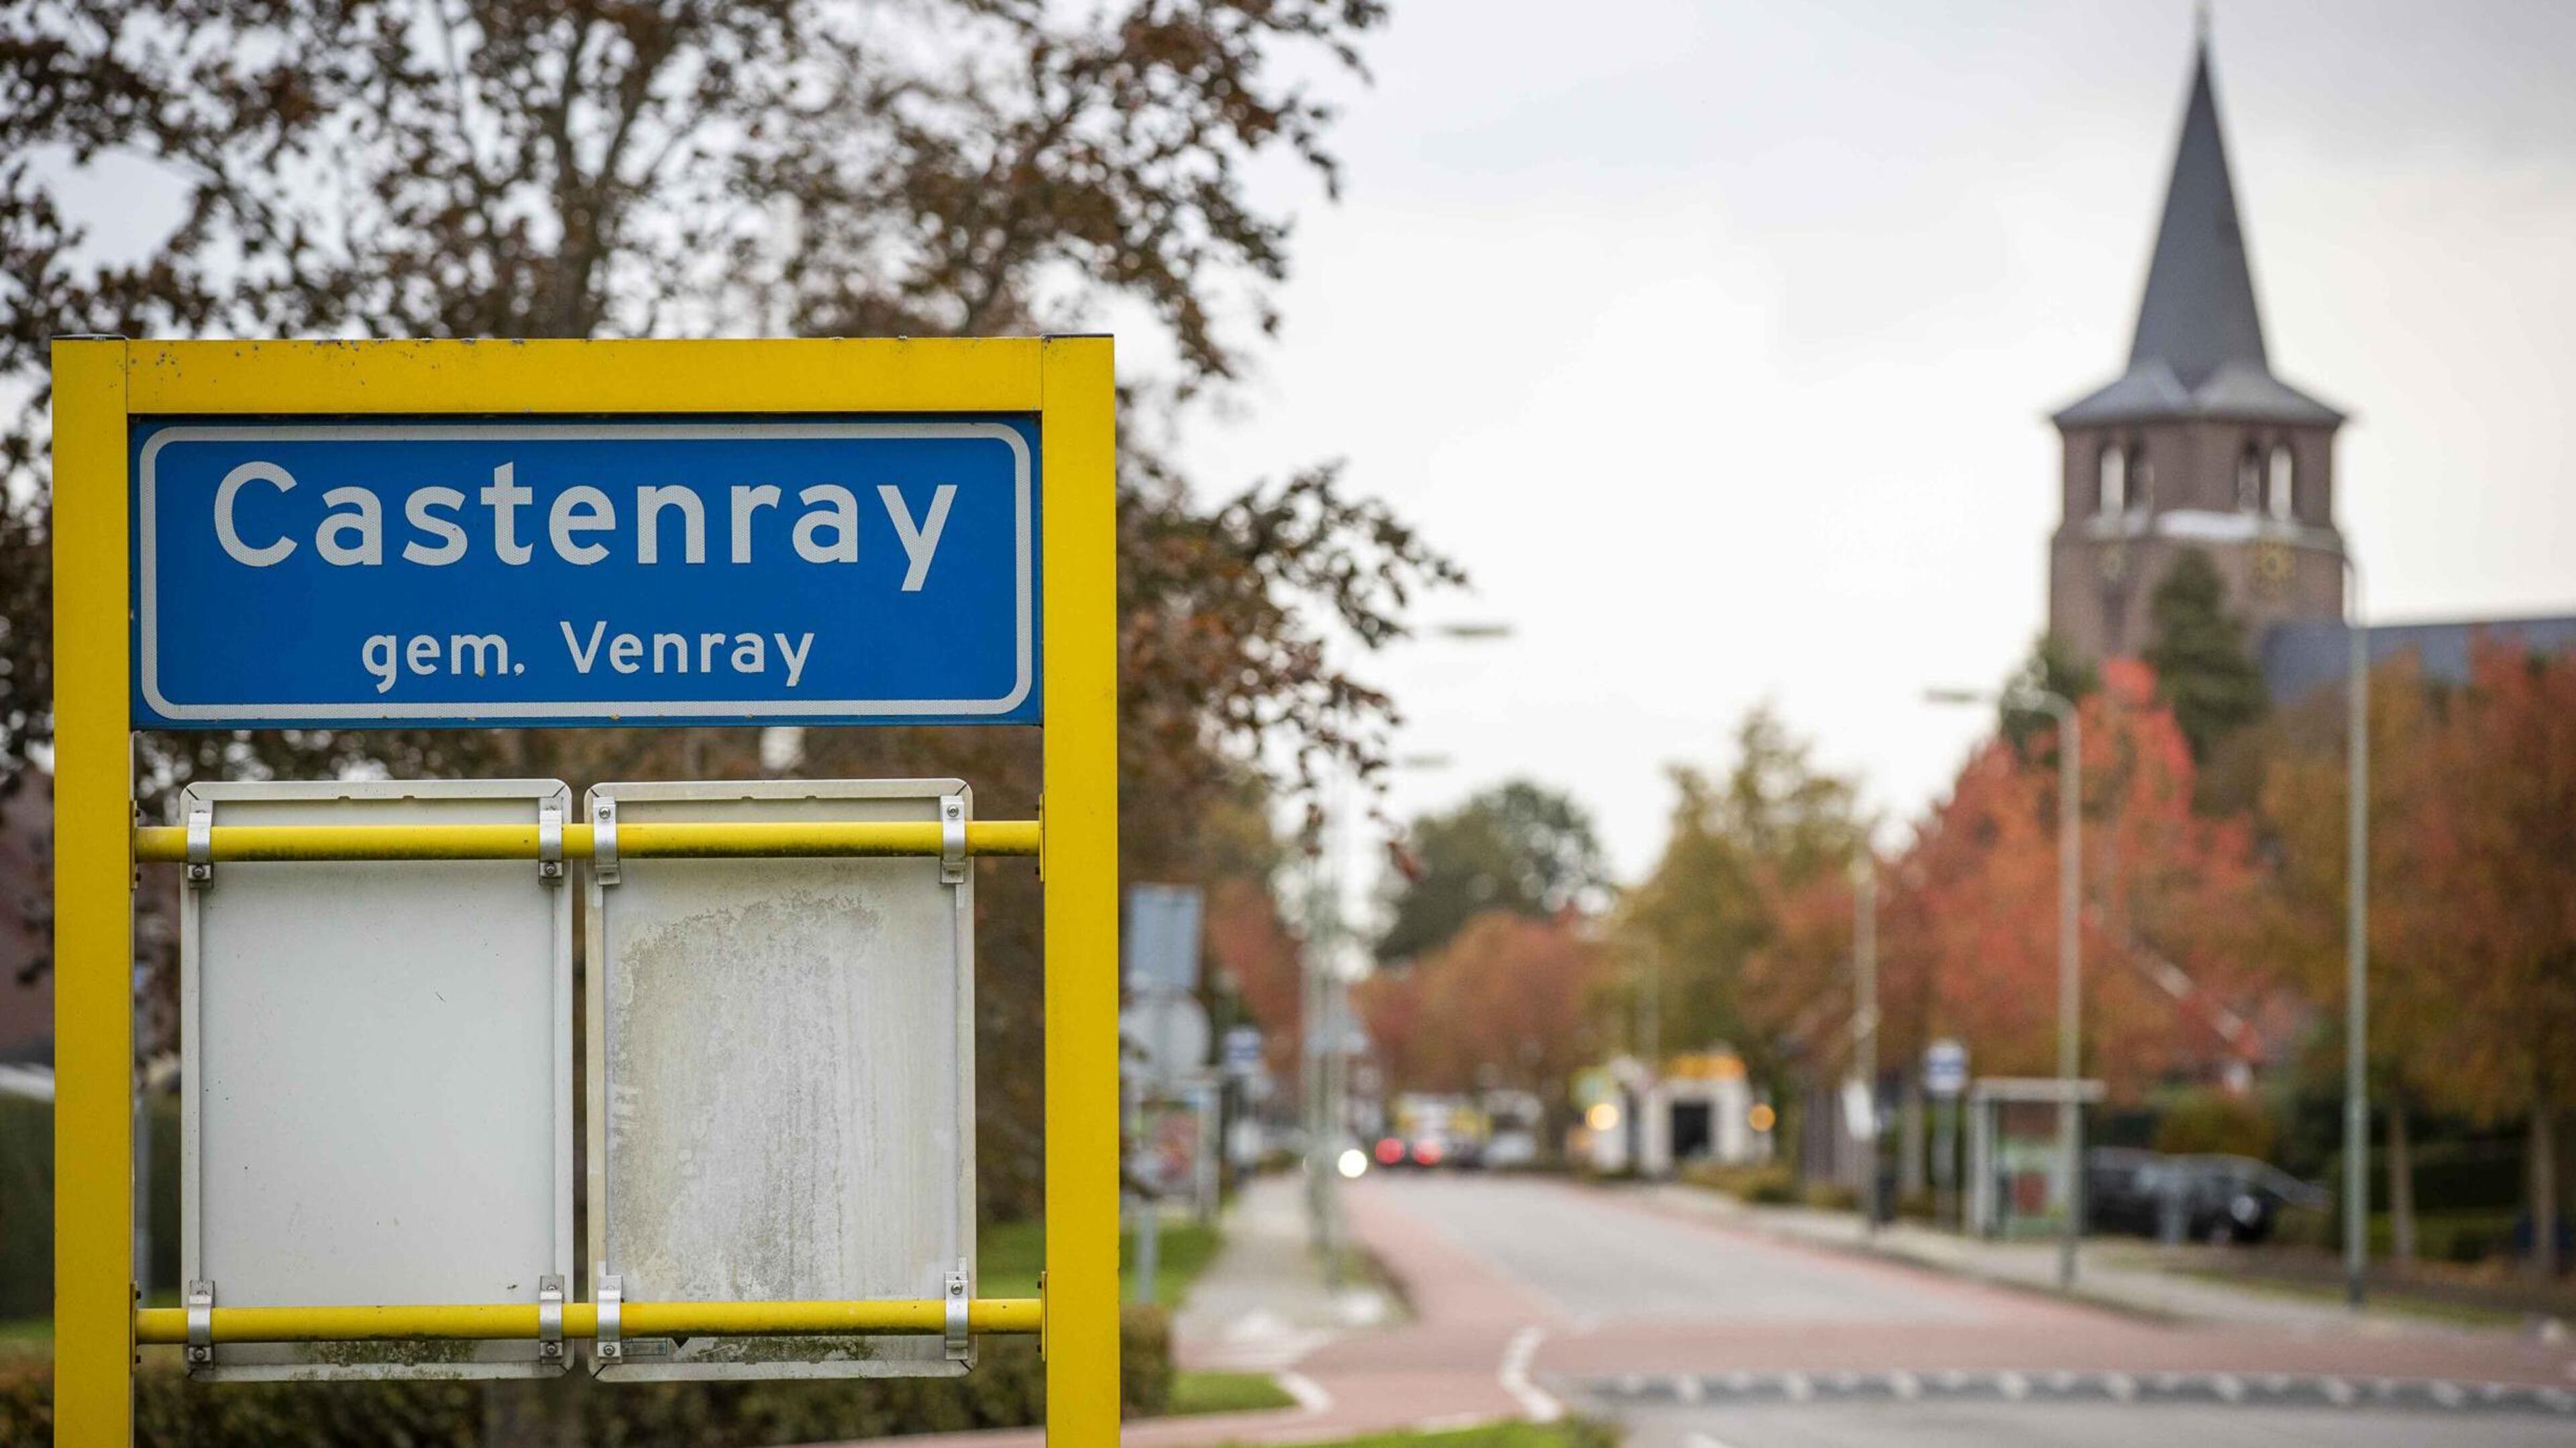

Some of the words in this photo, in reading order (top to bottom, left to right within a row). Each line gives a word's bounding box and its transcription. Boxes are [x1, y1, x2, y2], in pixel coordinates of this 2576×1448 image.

[215, 461, 957, 591] Castenray
[362, 634, 525, 694] gem.
[561, 620, 814, 687] Venray
